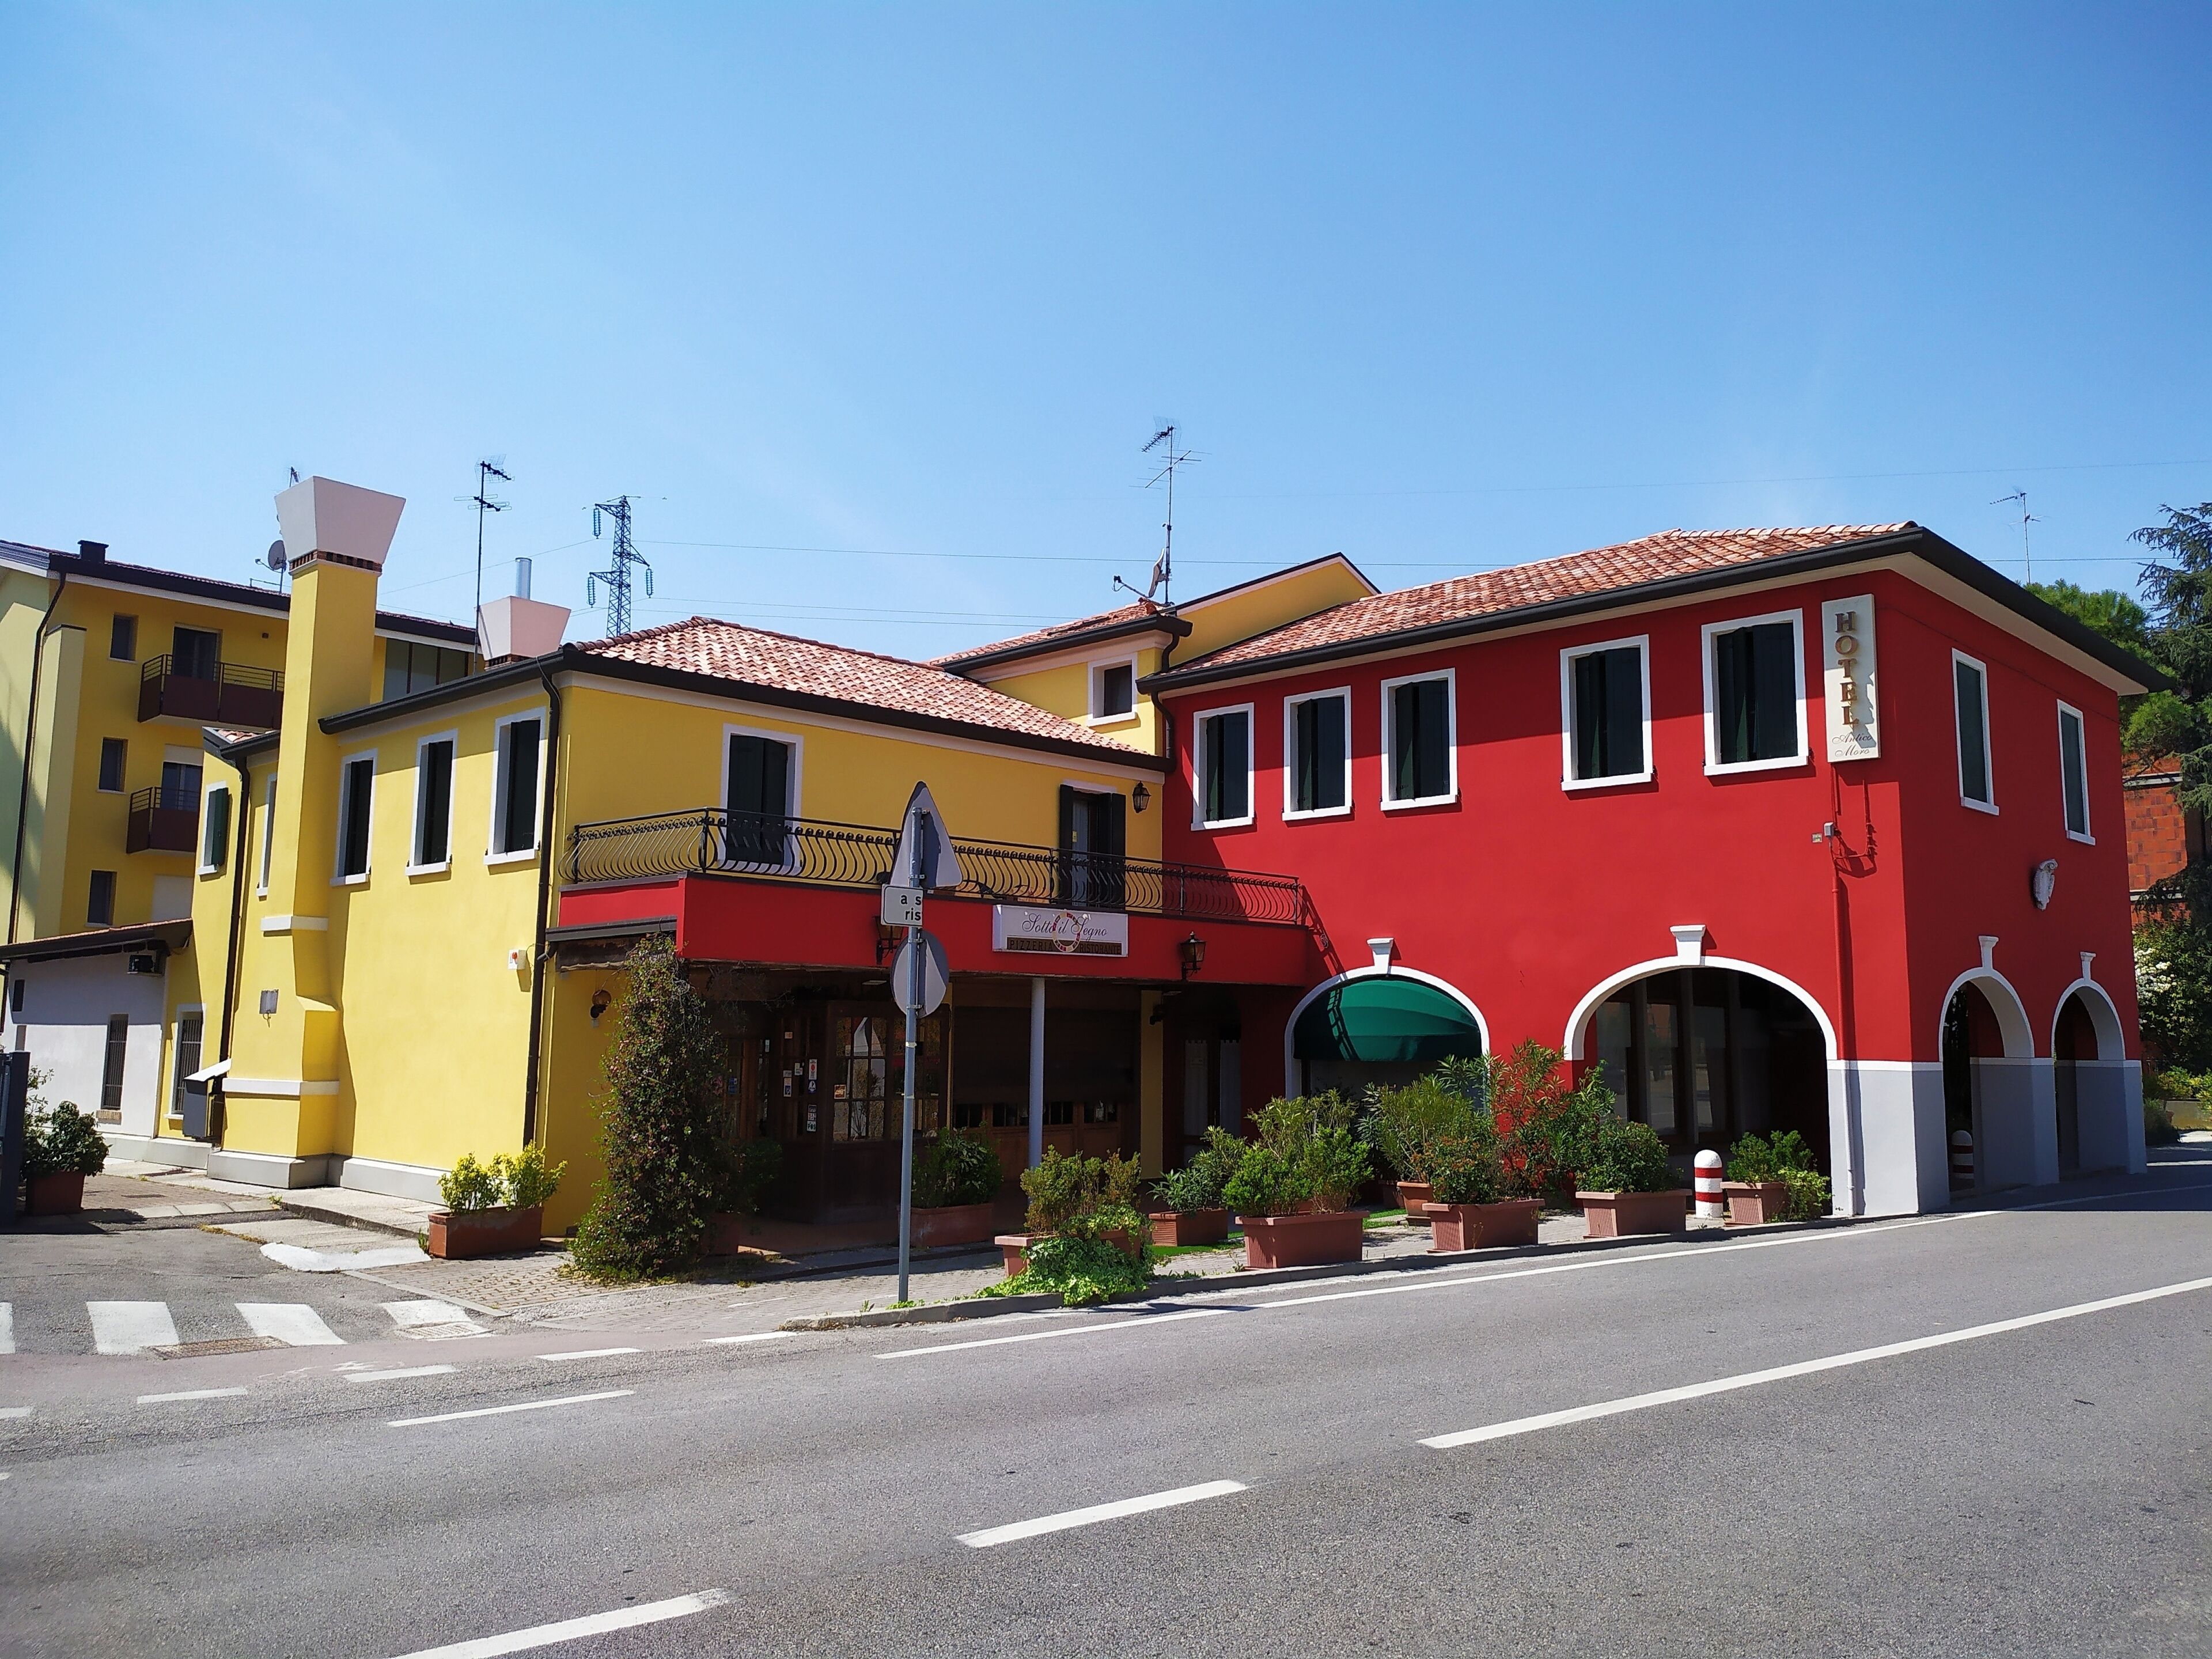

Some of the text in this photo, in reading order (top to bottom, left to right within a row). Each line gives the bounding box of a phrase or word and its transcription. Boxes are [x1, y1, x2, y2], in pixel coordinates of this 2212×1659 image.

[1835, 611, 1859, 726] HOTEL
[1832, 733, 1872, 744] Antico
[1834, 745, 1870, 757] Moro
[900, 895, 908, 905] a
[905, 907, 921, 921] ris
[1022, 913, 1108, 941] Sotto il Segno
[1010, 940, 1121, 955] PIZZERIA RISTORANTE
